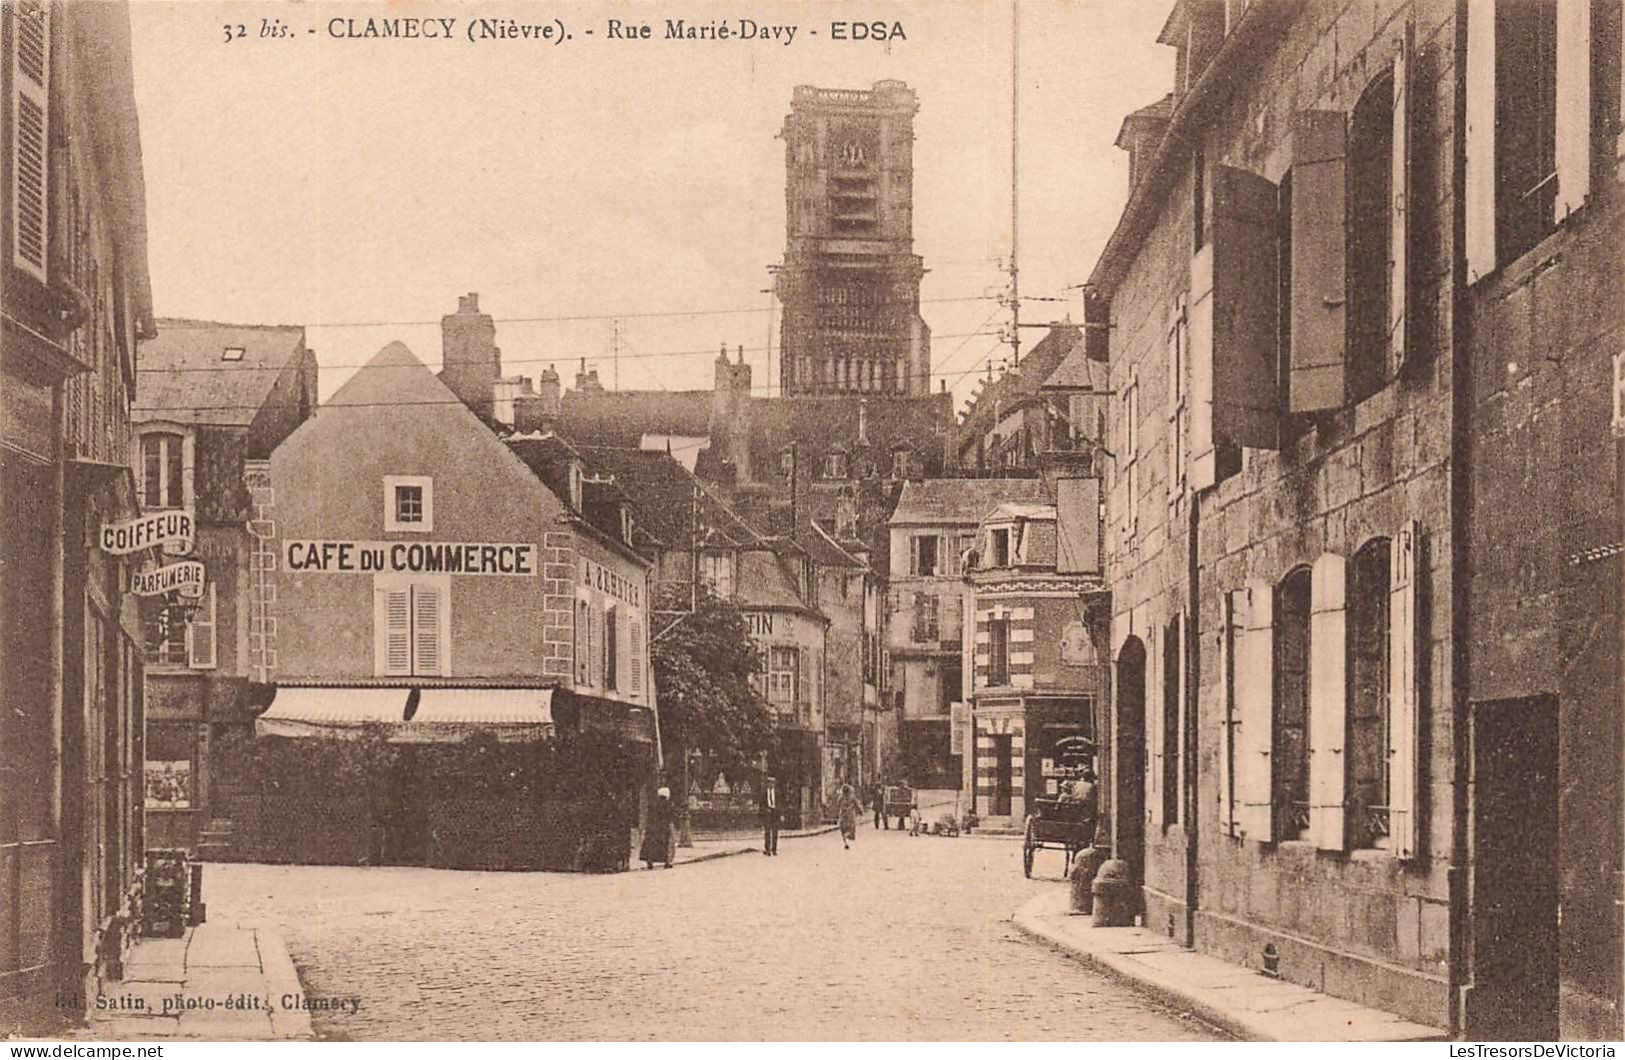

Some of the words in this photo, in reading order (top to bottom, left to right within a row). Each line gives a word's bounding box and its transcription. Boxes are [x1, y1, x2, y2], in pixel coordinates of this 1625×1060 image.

[103, 515, 190, 549] COIFFEUR
[287, 542, 355, 570] CAFE
[360, 549, 384, 571] DU
[390, 544, 532, 574] COMMERCE
[133, 565, 201, 592] PARFUMERIE
